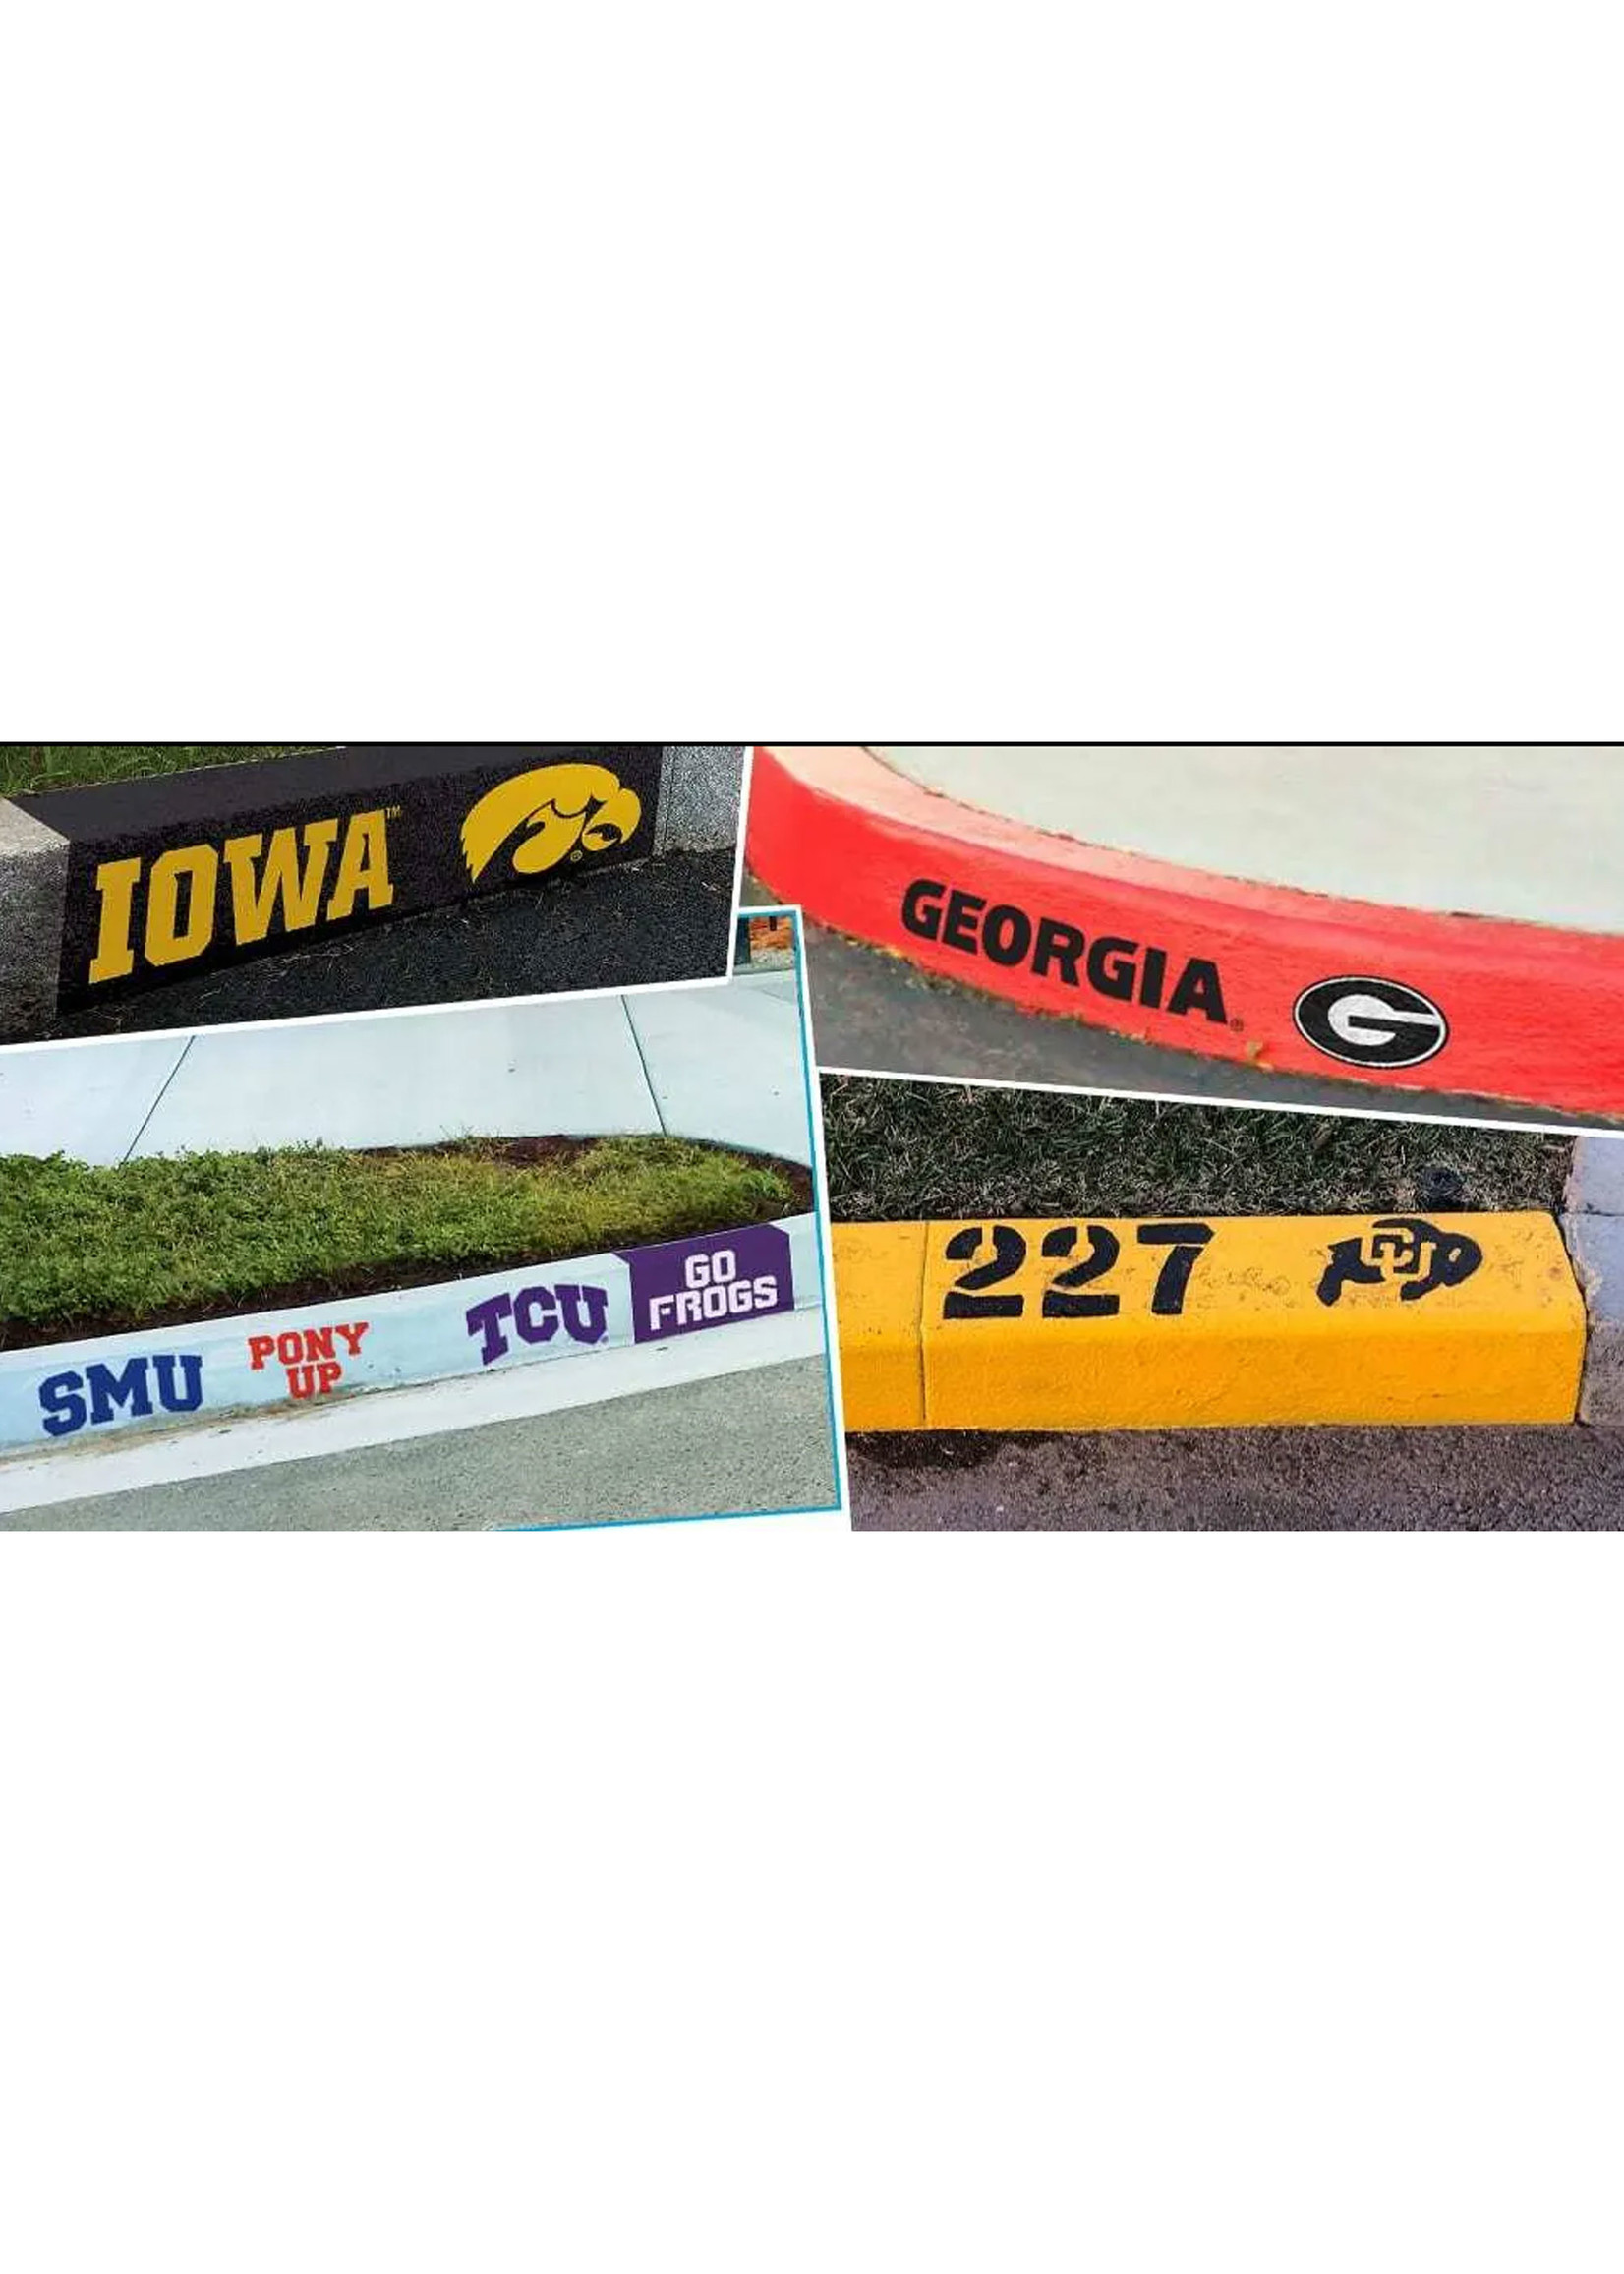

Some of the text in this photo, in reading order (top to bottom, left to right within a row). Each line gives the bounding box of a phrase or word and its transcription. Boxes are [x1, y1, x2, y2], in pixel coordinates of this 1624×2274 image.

[89, 808, 394, 983] IOWA
[901, 879, 1228, 1025] GEORGIA
[649, 1275, 779, 1331] FROGS
[685, 1250, 737, 1289] GO
[943, 1223, 1214, 1319] 227
[248, 1322, 369, 1370] PONY
[466, 1284, 608, 1365] TCU
[39, 1354, 203, 1436] SMU
[286, 1362, 342, 1400] UP
